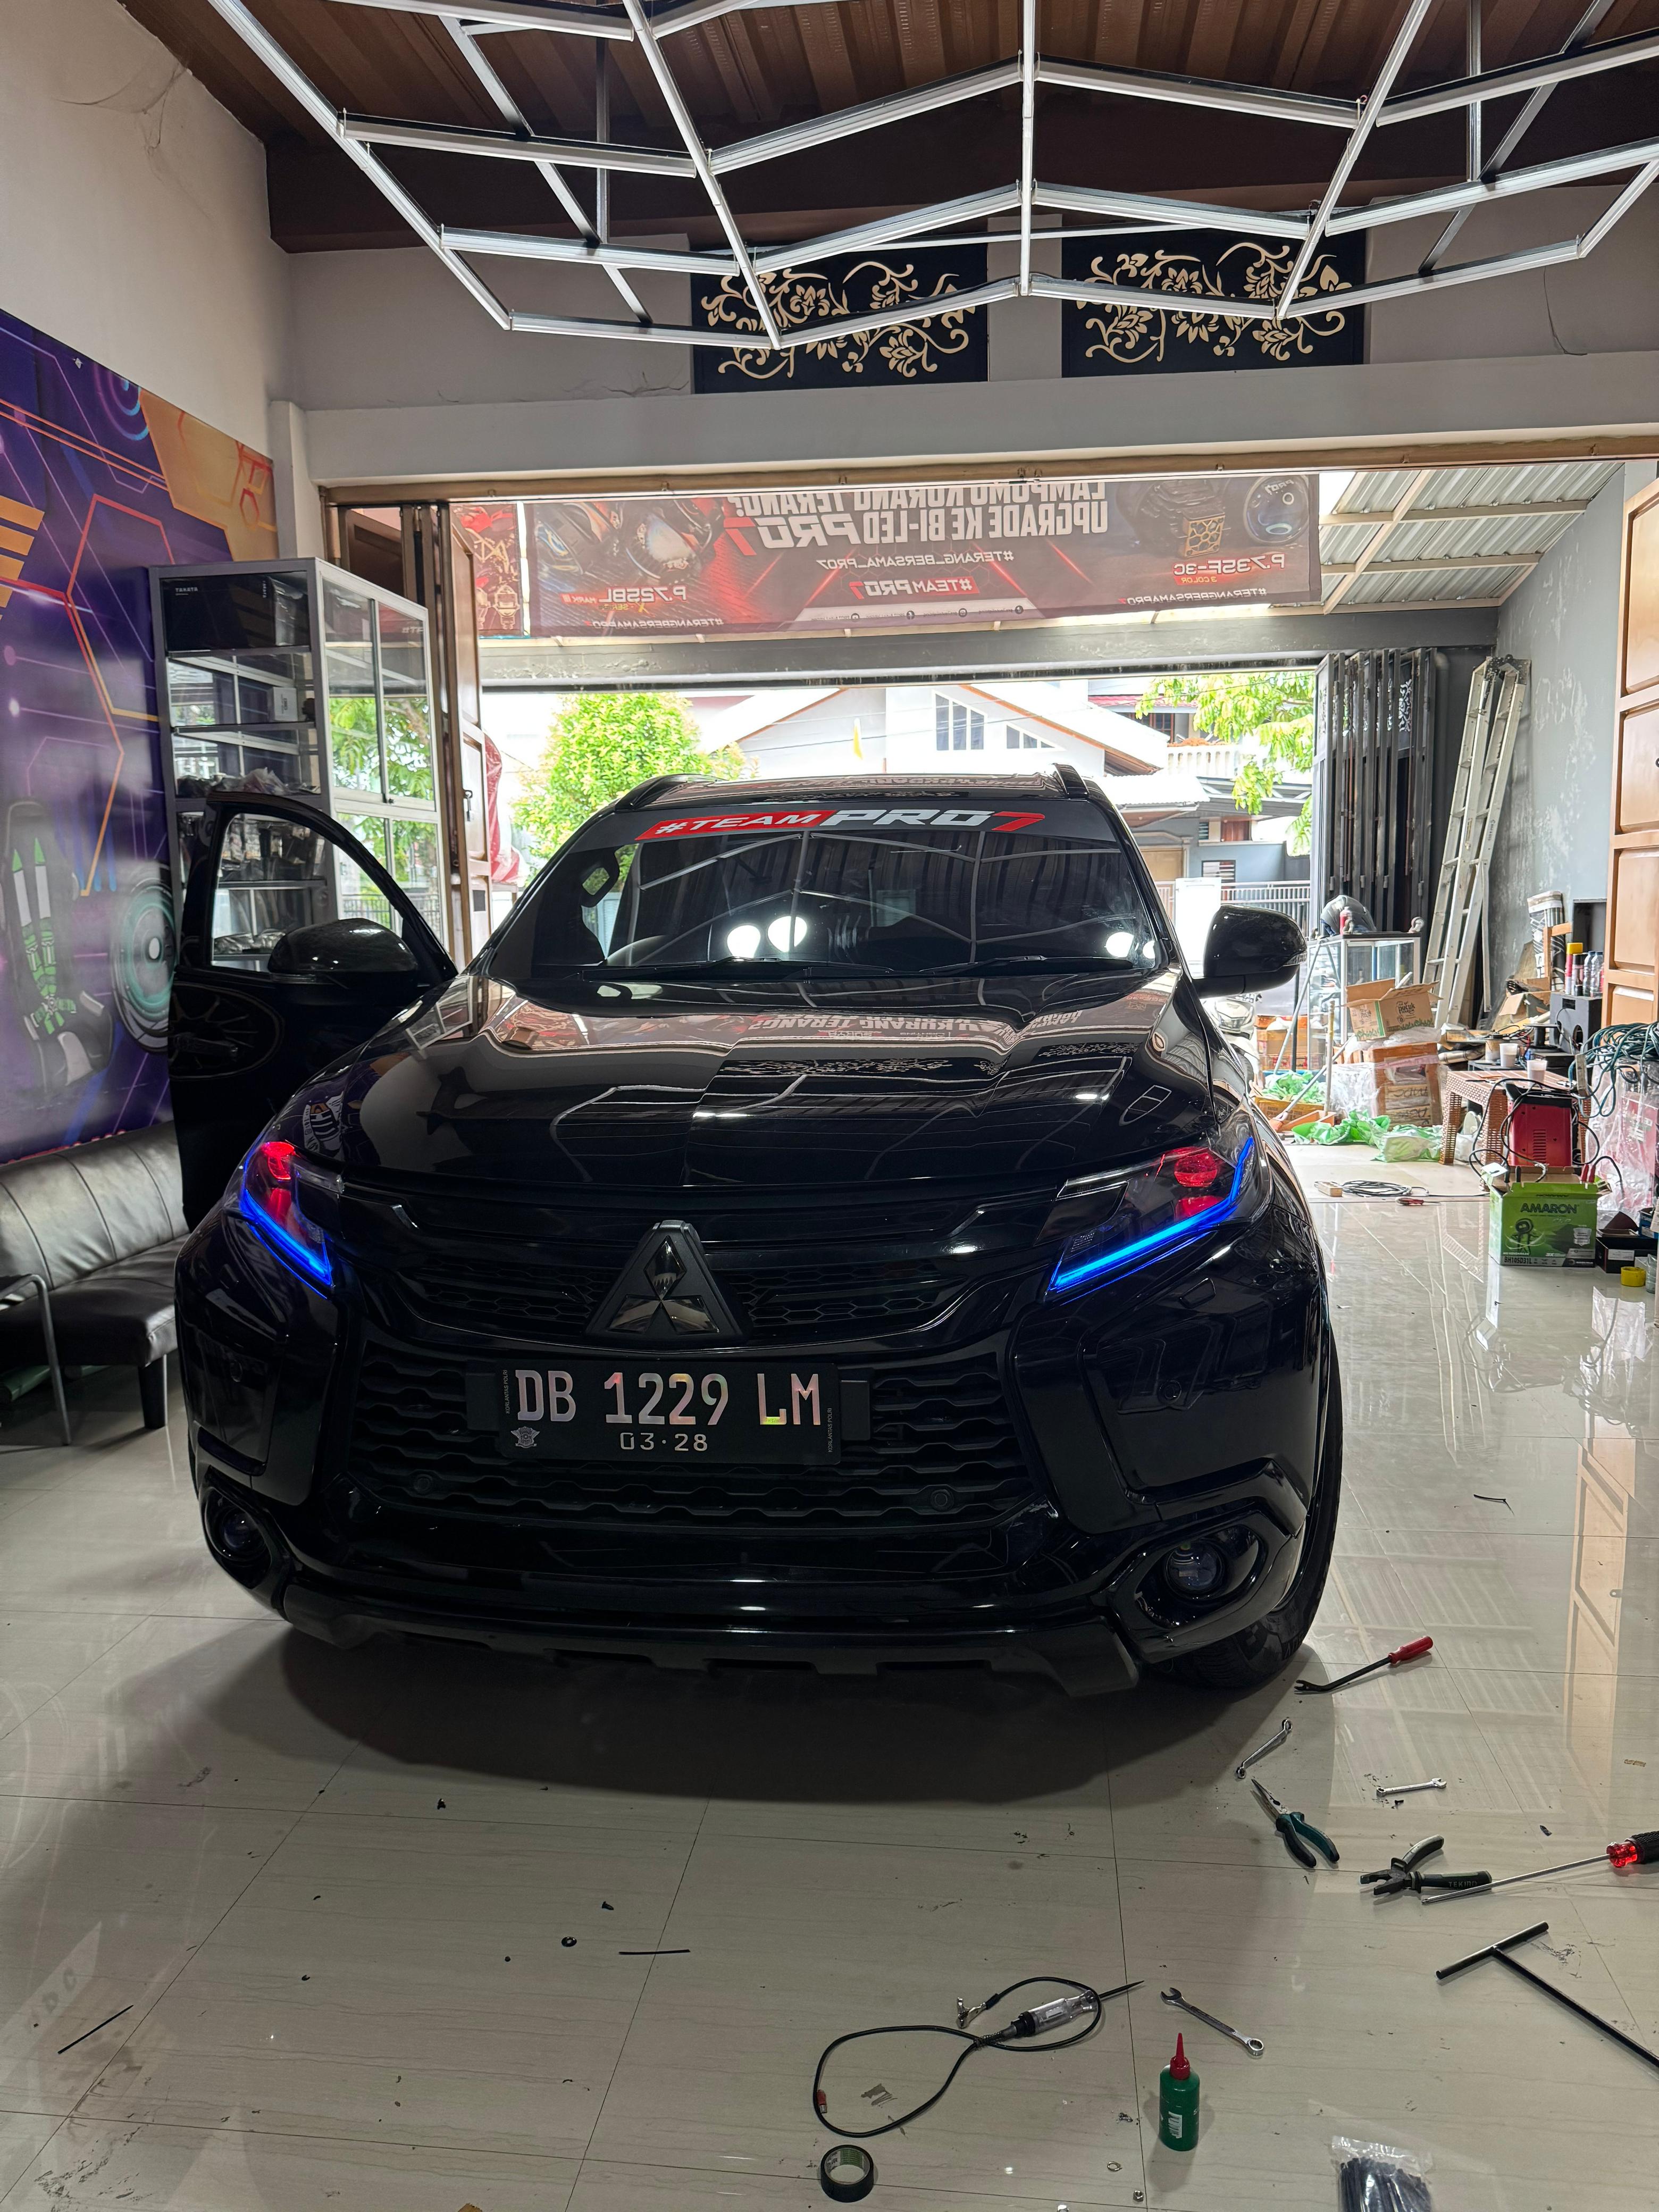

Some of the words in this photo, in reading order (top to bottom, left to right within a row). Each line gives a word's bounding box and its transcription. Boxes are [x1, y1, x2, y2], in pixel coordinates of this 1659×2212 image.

[1520, 1202, 1578, 1214] AMARON
[515, 1369, 576, 1422] DB
[604, 1372, 729, 1426] 1229
[757, 1373, 821, 1426] LM
